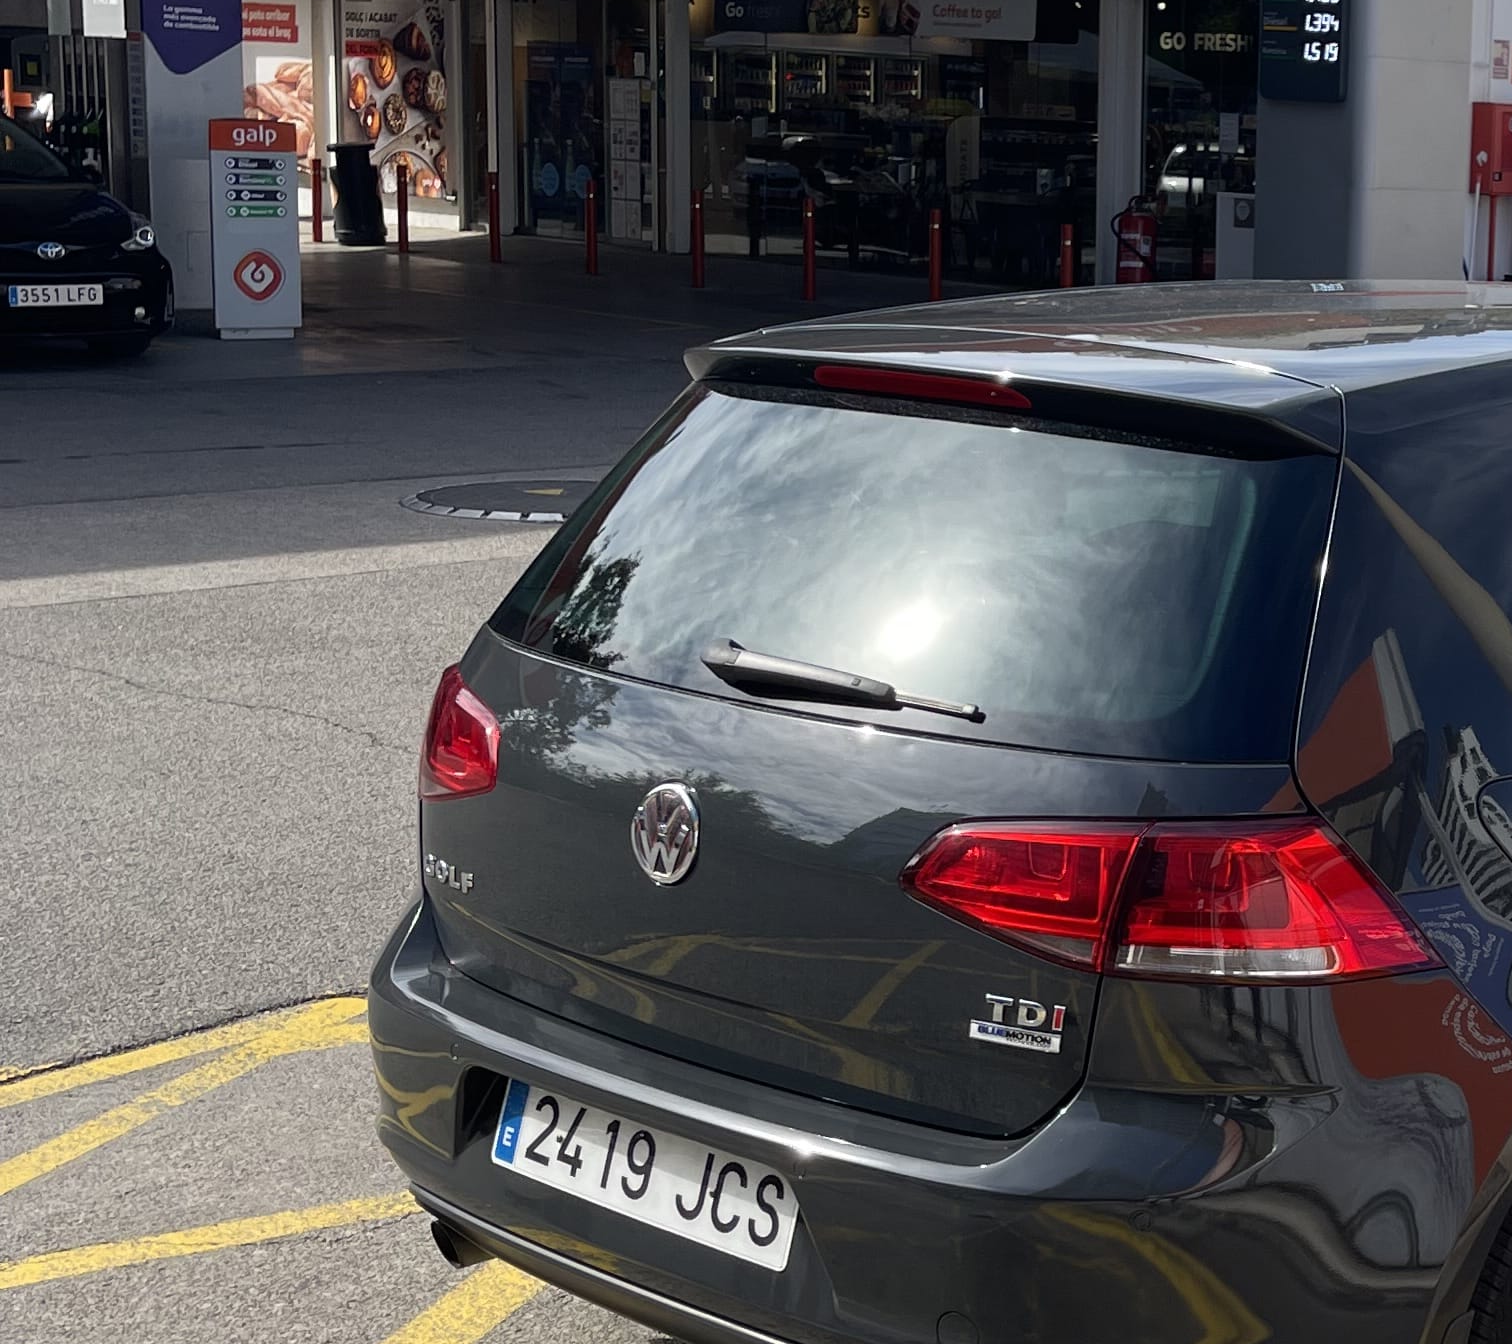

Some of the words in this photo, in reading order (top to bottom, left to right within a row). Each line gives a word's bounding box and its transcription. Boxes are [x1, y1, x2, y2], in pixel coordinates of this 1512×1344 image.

[725, 1, 744, 18] Go
[932, 3, 968, 19] Coffee
[970, 5, 983, 19] to
[1159, 32, 1186, 51] GO
[232, 124, 278, 146] galp
[20, 287, 60, 304] 3551
[67, 287, 97, 303] LFG
[985, 993, 1067, 1032] TDI
[524, 1095, 656, 1201] 2419
[675, 1153, 784, 1247] JCS
